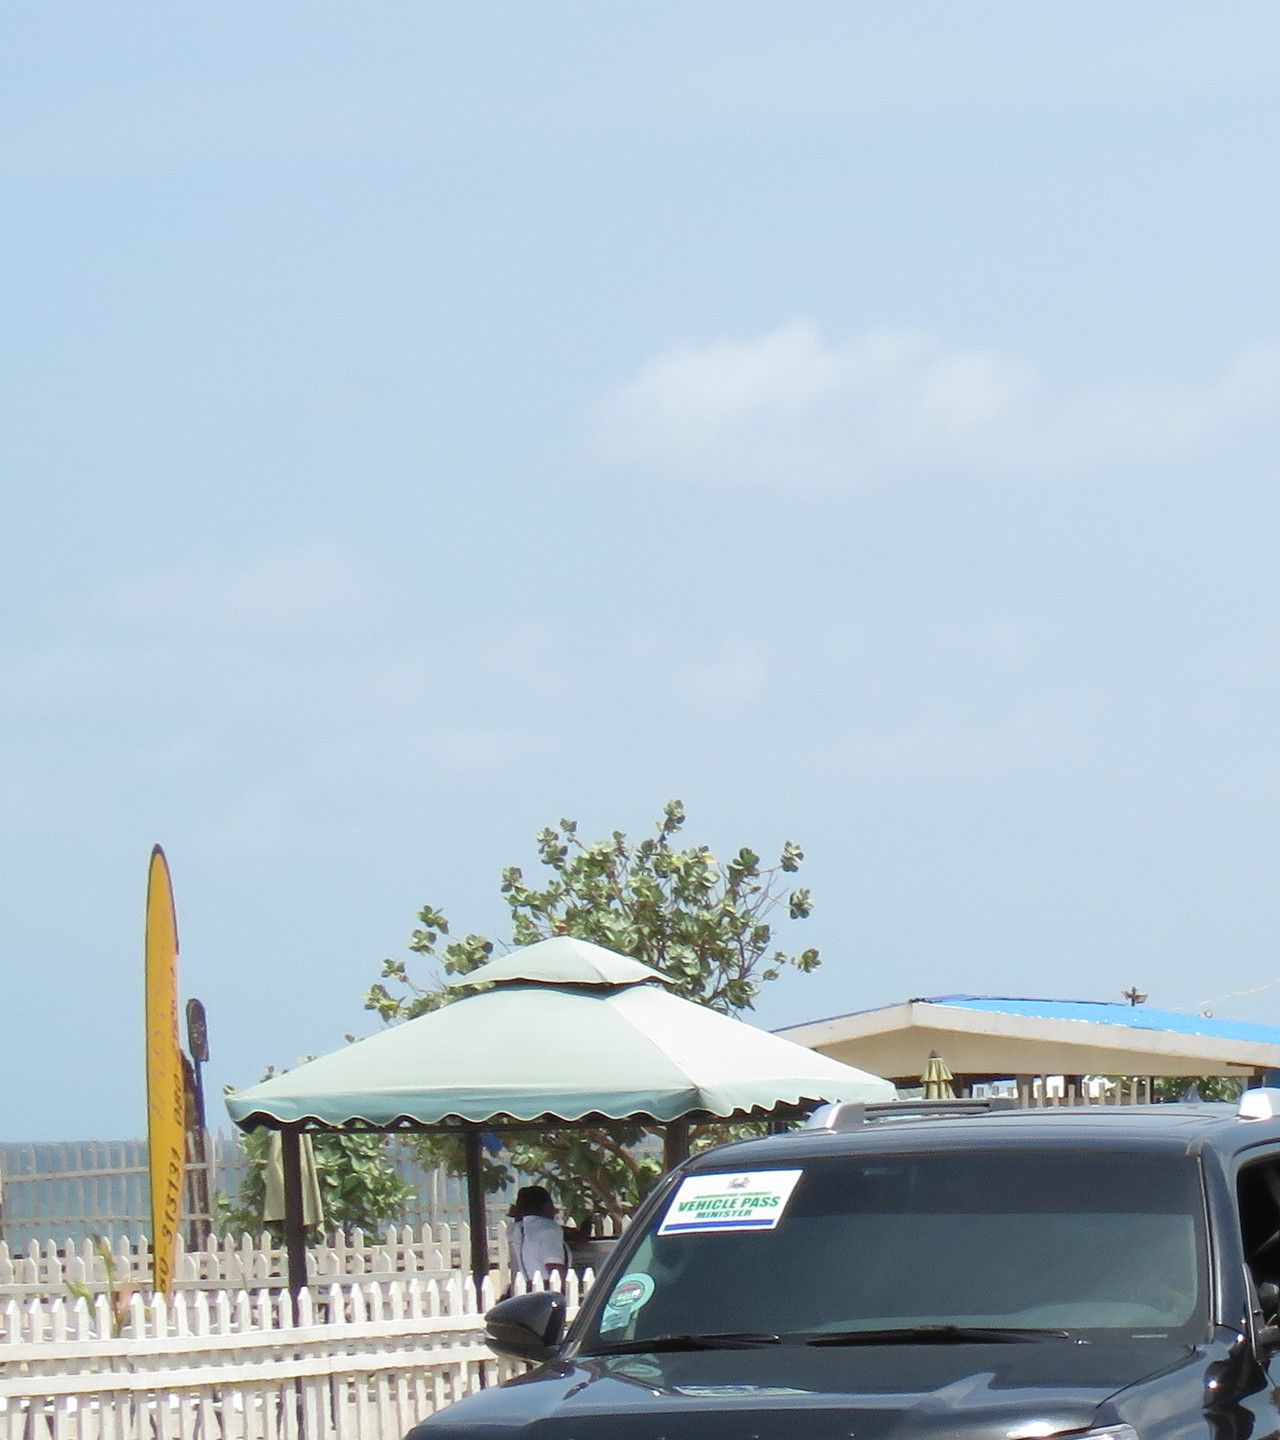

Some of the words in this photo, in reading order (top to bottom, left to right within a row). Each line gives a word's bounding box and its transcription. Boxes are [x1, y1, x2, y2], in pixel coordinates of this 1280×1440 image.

[678, 1198, 737, 1213] VEHICLE
[740, 1196, 781, 1209] PASS
[695, 1210, 752, 1219] MINISTER
